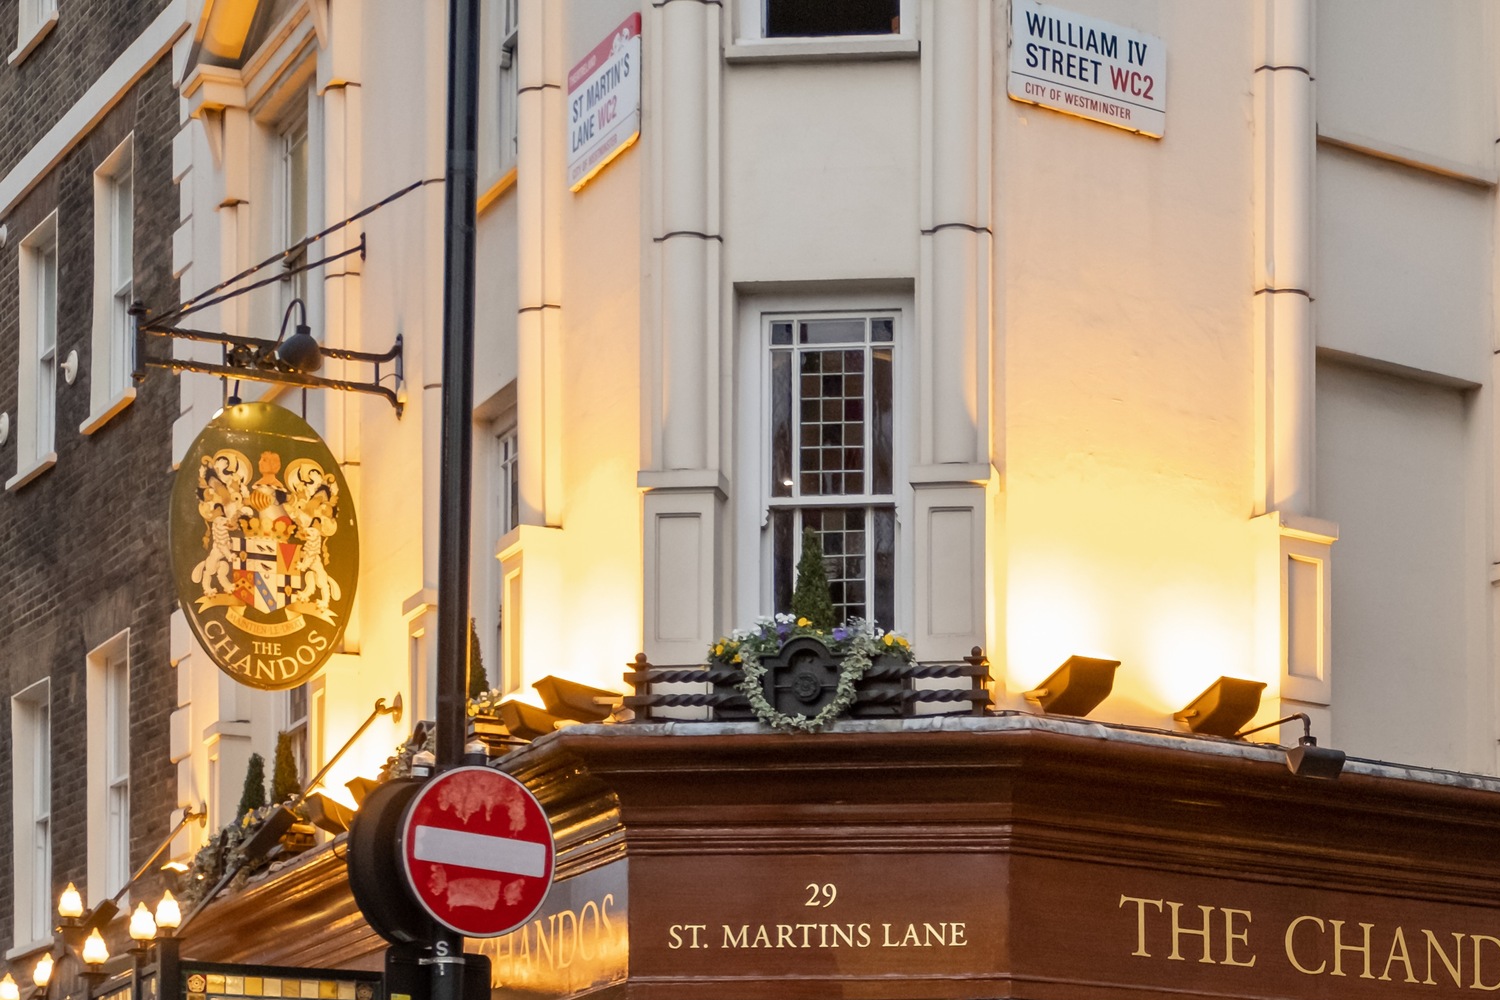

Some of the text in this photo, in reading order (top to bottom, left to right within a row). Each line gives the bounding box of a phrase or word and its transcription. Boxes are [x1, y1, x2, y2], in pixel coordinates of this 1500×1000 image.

[1025, 10, 1147, 66] WILLIAM IV
[572, 94, 583, 123] ST
[586, 53, 630, 111] MARTIN'S
[1025, 43, 1154, 100] STREET WC2
[572, 95, 617, 152] LANE WC2
[1025, 82, 1131, 120] CITY OF WESTMINSTER
[204, 620, 327, 681] CHANDOS
[252, 641, 282, 656] THE
[804, 883, 837, 908] 29
[667, 922, 968, 950] ST. MARTINS LANE
[1119, 893, 1257, 968] THE
